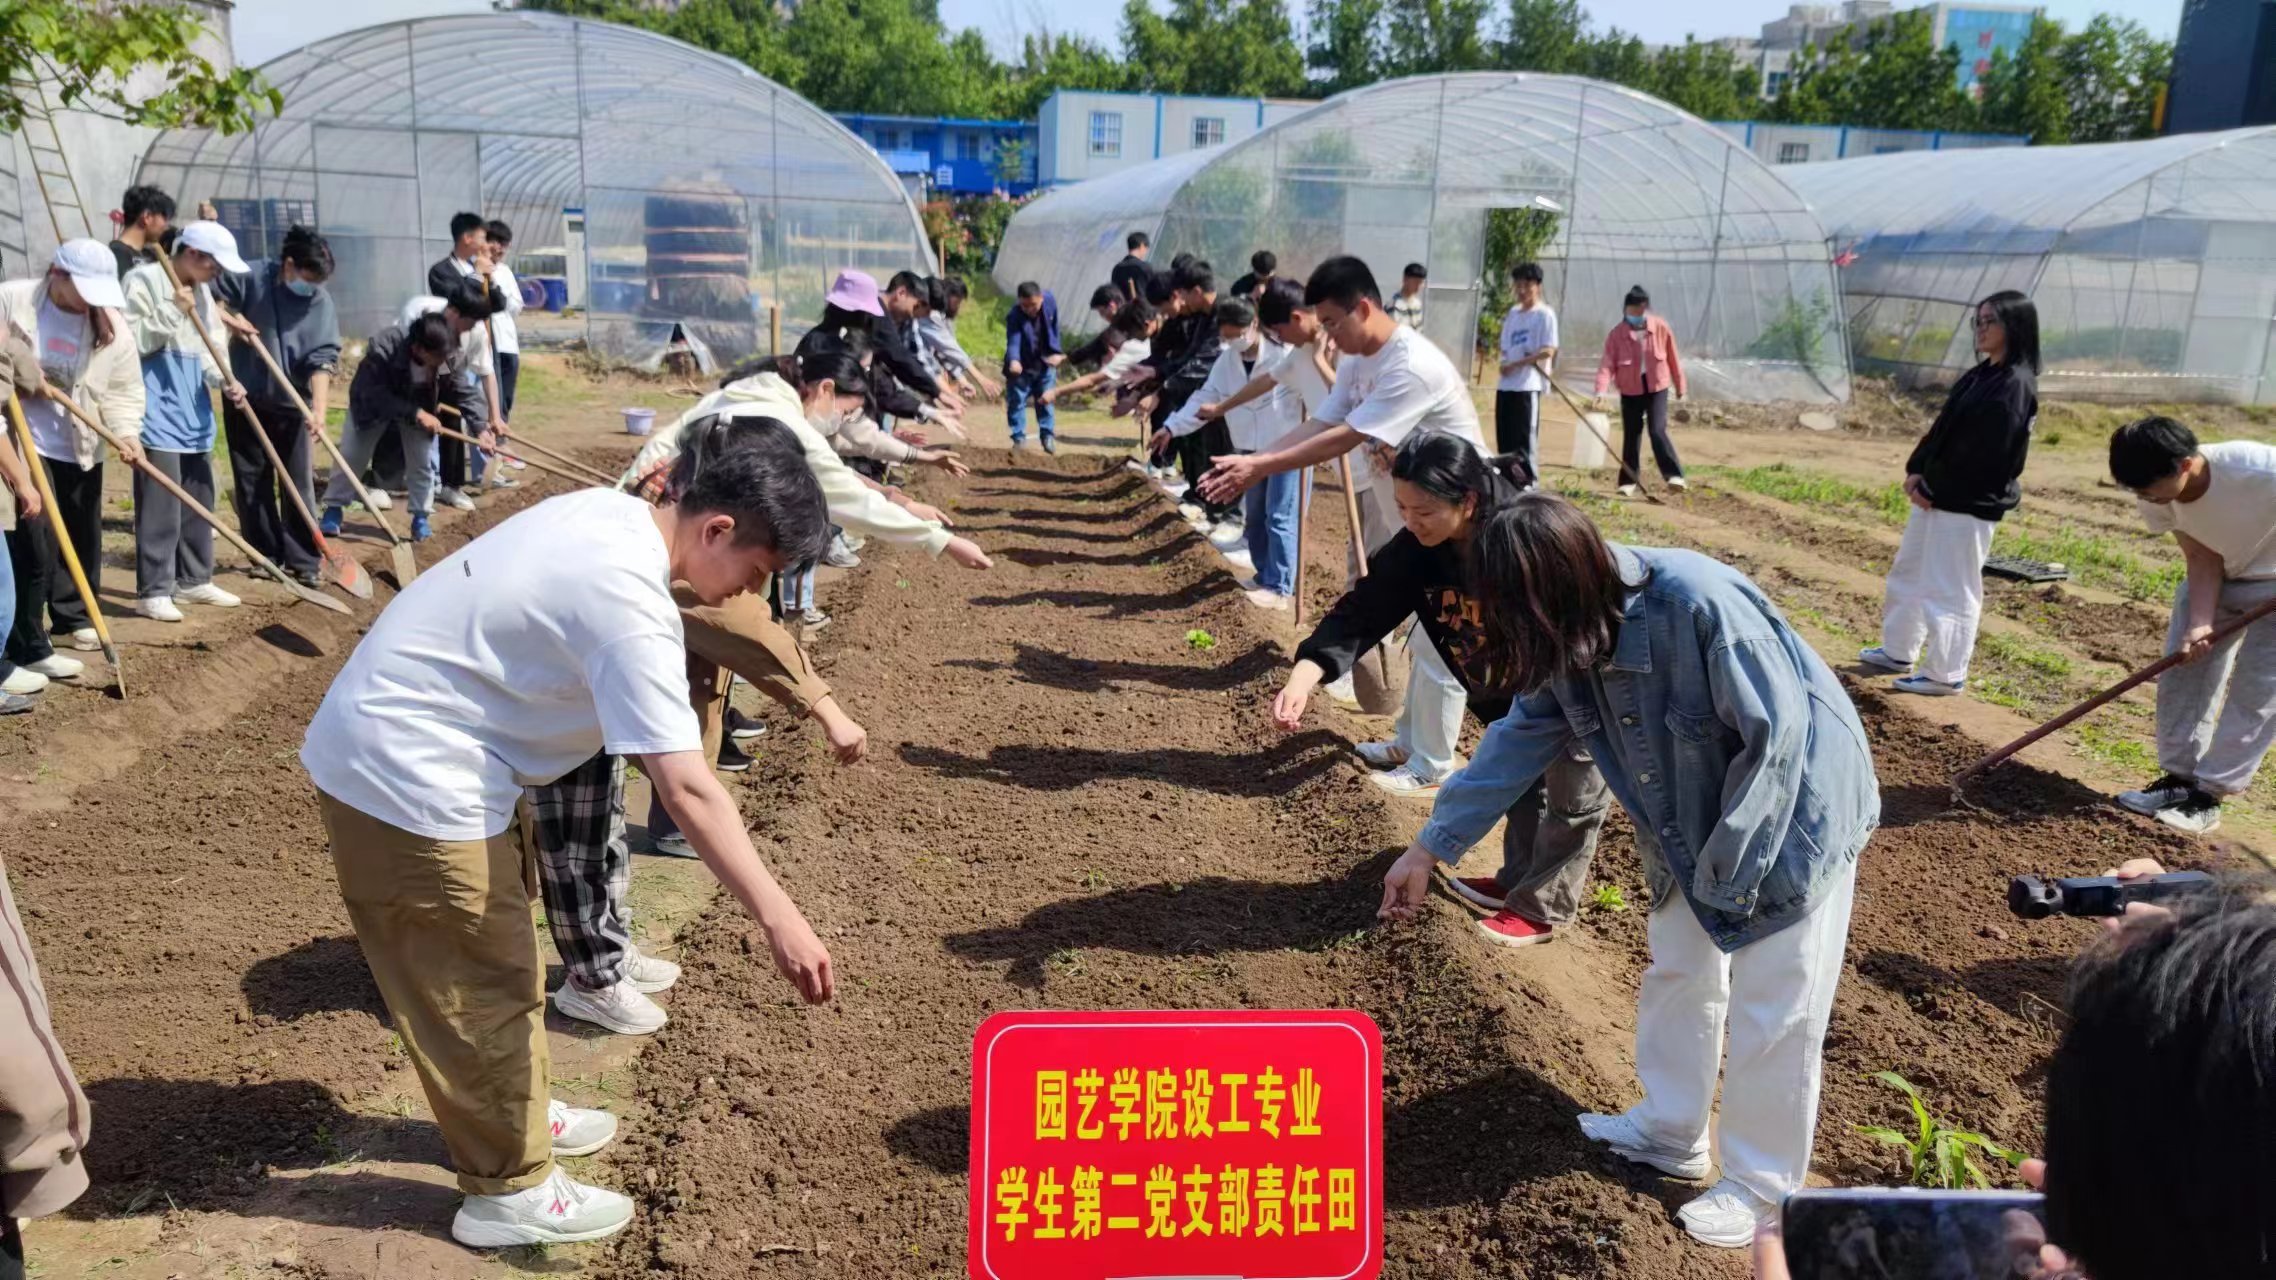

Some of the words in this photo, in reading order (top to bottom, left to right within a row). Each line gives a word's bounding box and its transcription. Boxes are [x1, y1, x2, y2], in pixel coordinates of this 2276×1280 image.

[1035, 1065, 1322, 1141] 园艺学院设工专业
[996, 1163, 1355, 1242] 学生第二党支部责任田
